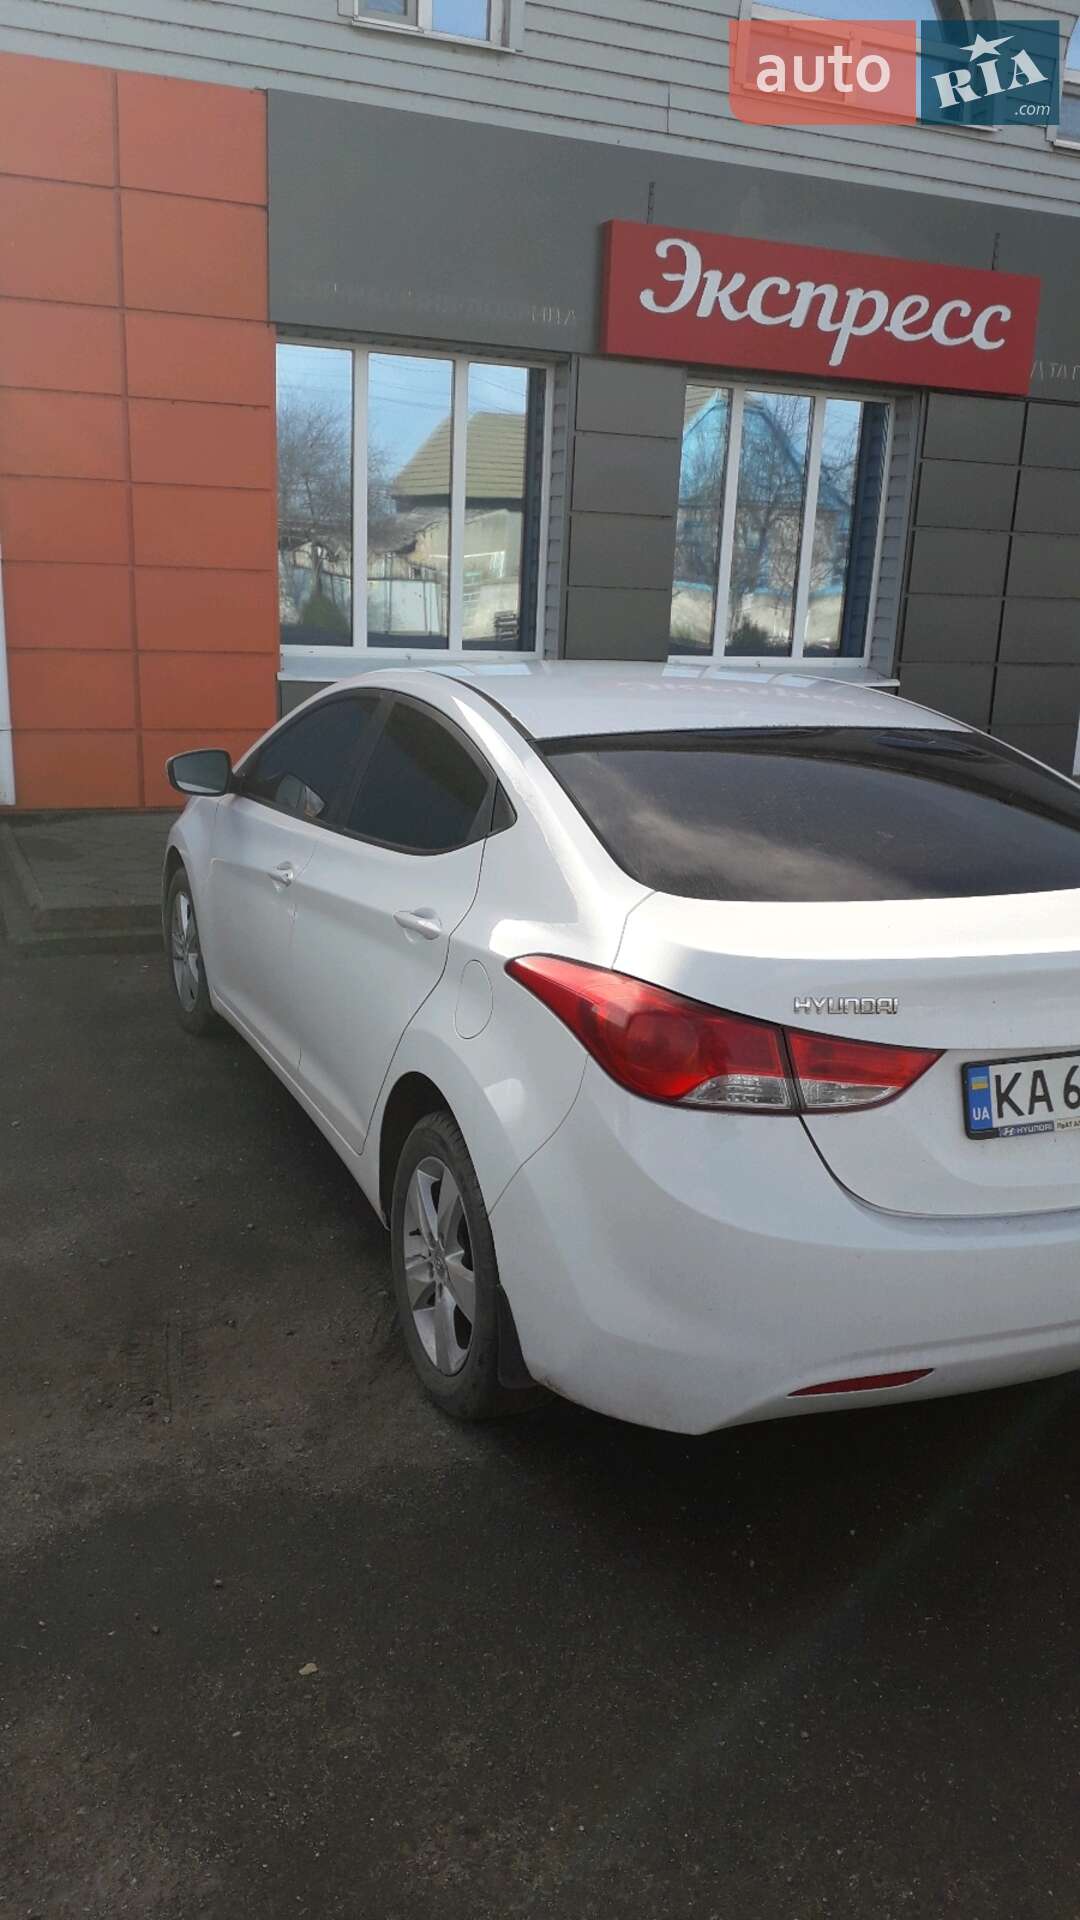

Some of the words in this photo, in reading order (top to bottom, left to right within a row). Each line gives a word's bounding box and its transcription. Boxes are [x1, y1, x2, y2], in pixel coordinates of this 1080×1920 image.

[639, 238, 1012, 366] Экспресс
[793, 997, 898, 1015] HYUNDAI
[972, 1106, 991, 1121] UA
[1016, 1122, 1053, 1134] HYUNDAI
